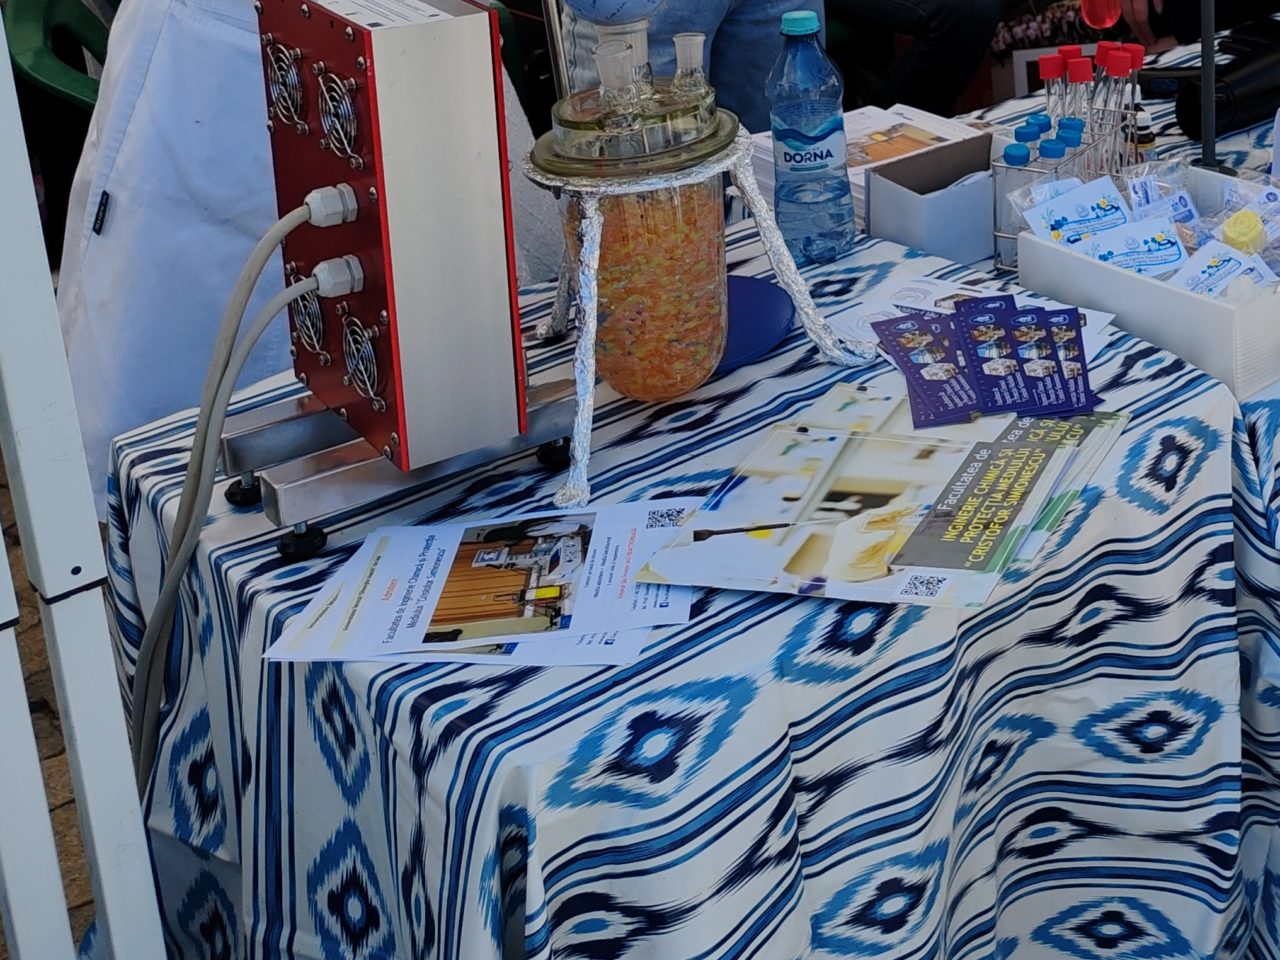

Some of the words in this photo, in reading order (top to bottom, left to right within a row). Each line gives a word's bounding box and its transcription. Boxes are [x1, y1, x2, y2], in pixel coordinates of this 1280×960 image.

[784, 149, 833, 163] DORNA
[936, 461, 983, 510] Facultatea
[971, 448, 992, 460] de
[959, 490, 1006, 542] PROTECȚIA
[995, 447, 1031, 489] MEDIULUI
[940, 496, 983, 541] INGINERIE
